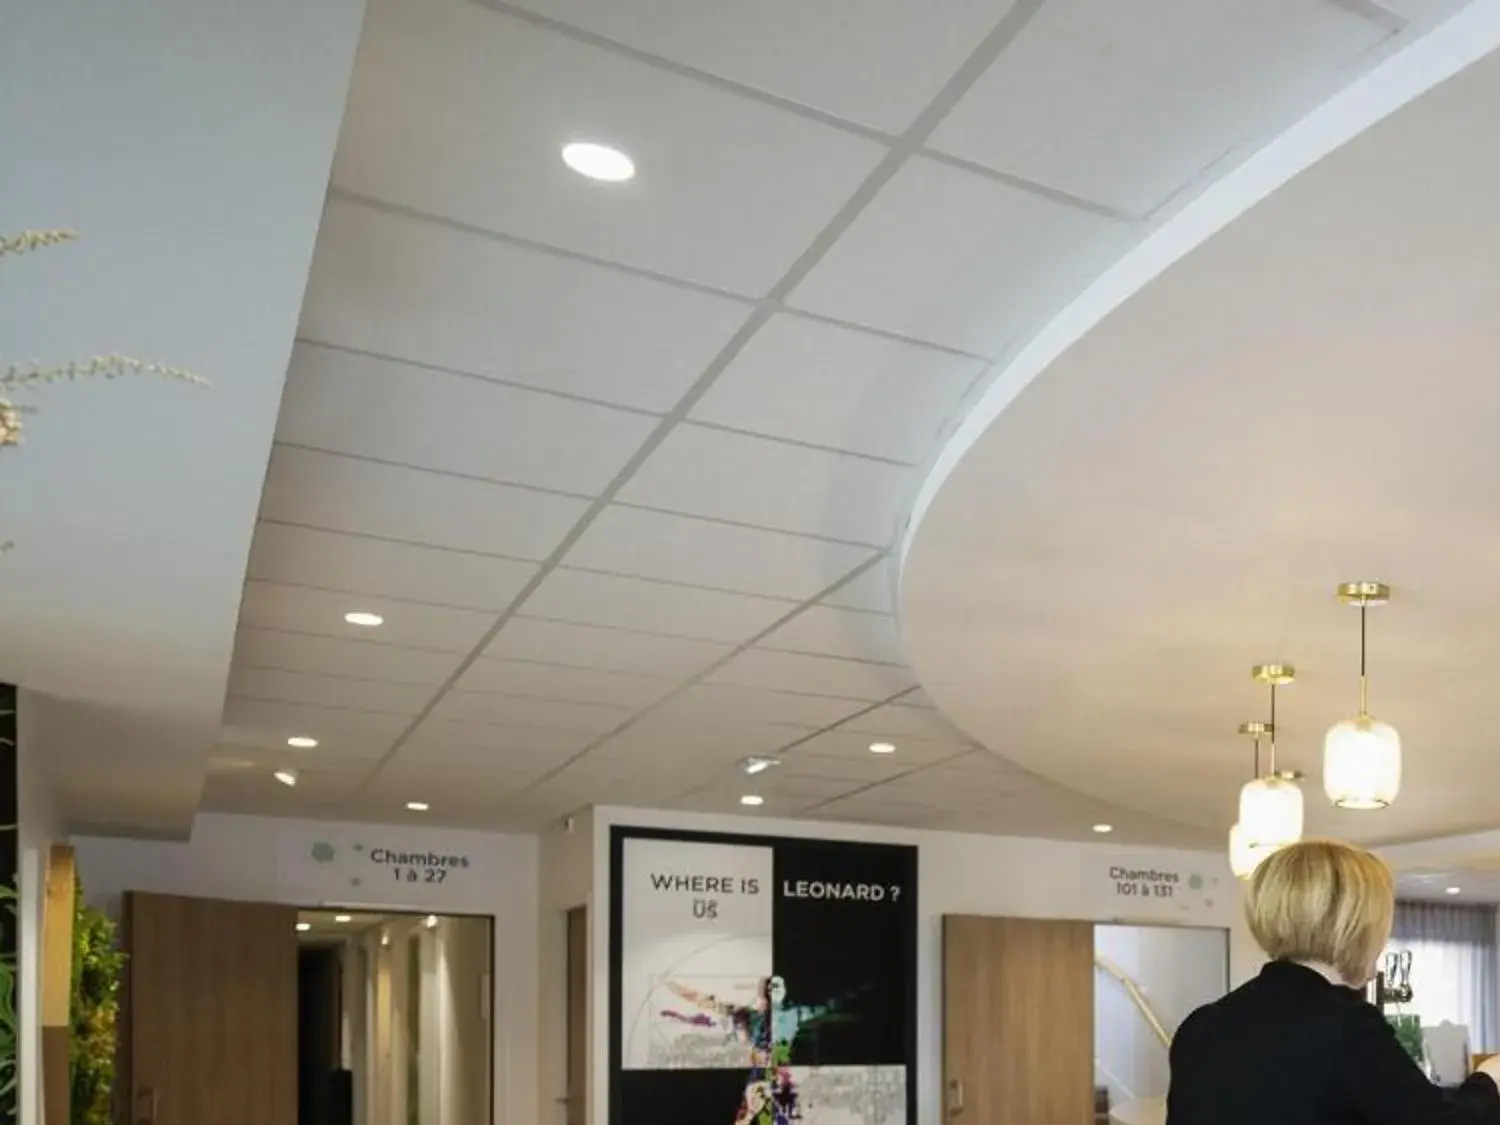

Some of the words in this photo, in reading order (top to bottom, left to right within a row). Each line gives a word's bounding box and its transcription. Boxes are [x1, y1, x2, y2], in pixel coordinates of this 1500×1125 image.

[370, 848, 470, 868] Chambres
[394, 867, 400, 881] 1
[406, 868, 418, 882] à
[424, 868, 447, 883] 27
[1109, 866, 1179, 883] Chambres
[649, 873, 734, 893] WHERE
[740, 878, 760, 894] IS
[783, 879, 885, 901] LEONARD
[890, 884, 901, 902] ?
[1116, 883, 1137, 895] 101
[1153, 884, 1173, 898] 131
